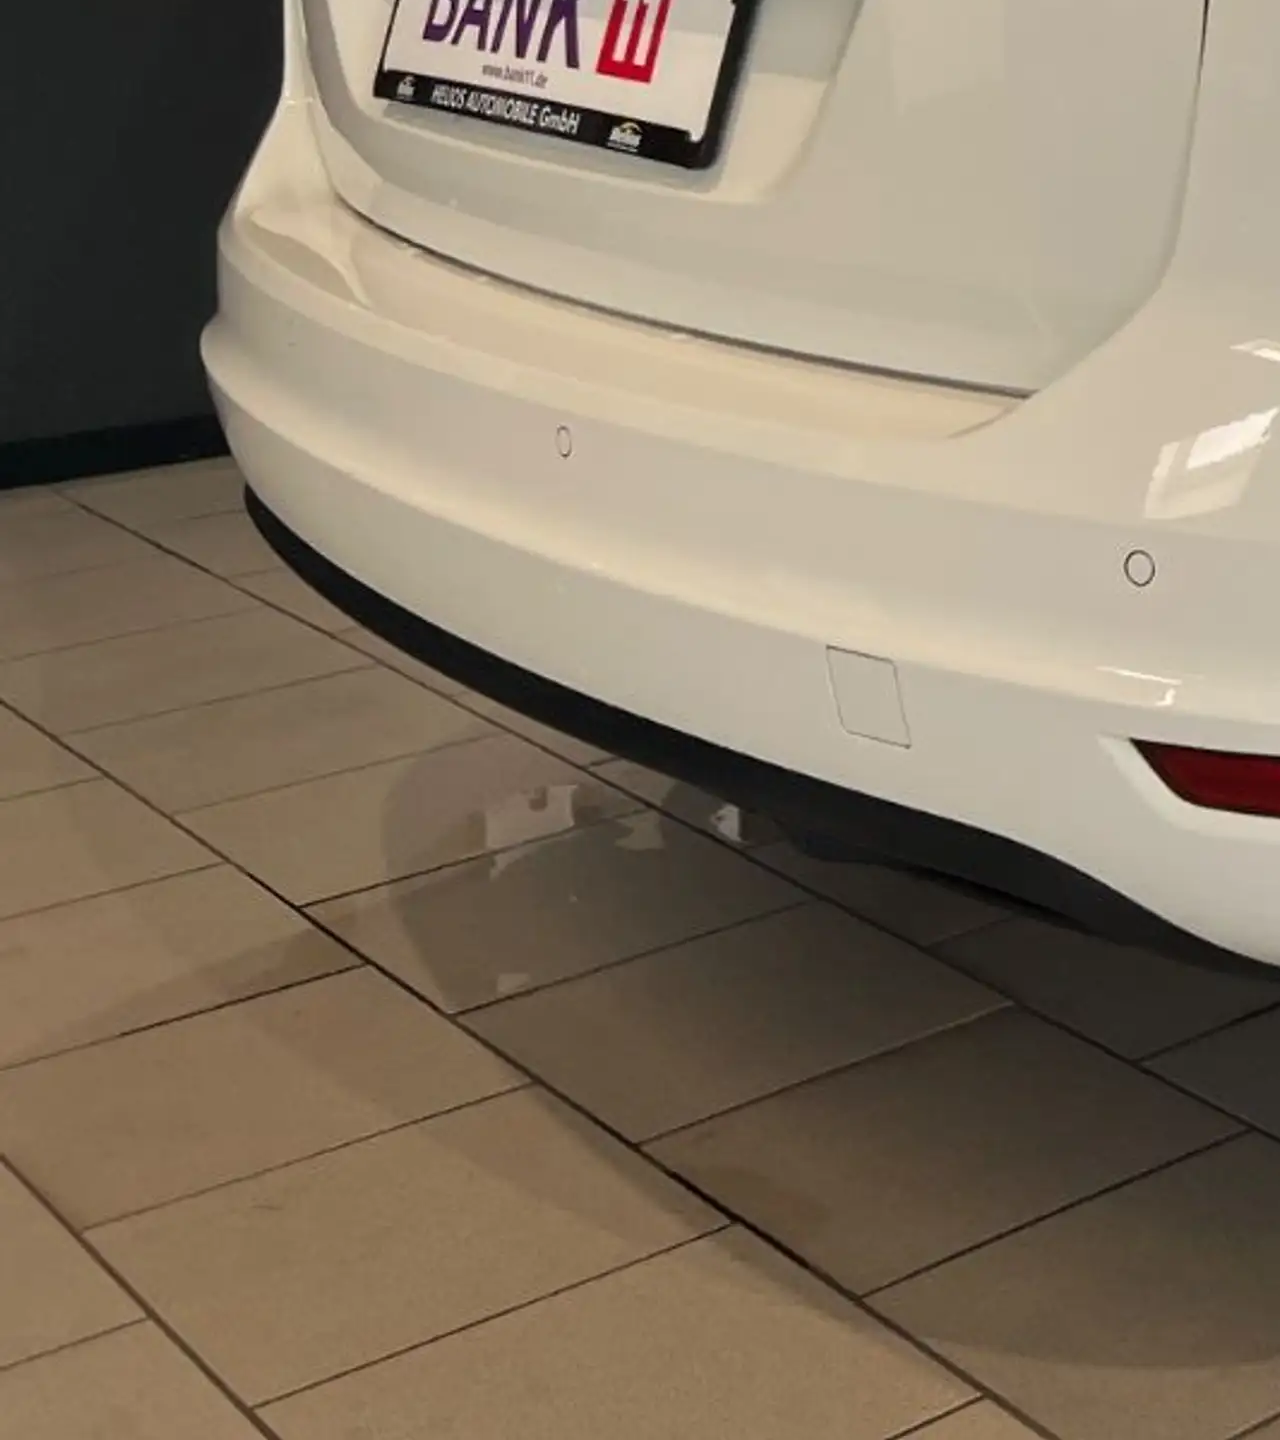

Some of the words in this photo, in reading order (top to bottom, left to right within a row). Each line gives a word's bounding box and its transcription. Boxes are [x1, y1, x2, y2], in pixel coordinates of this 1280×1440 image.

[430, 83, 467, 109] HELIOS
[466, 91, 539, 125] AUTOMOBILE
[540, 104, 581, 135] GmbH
